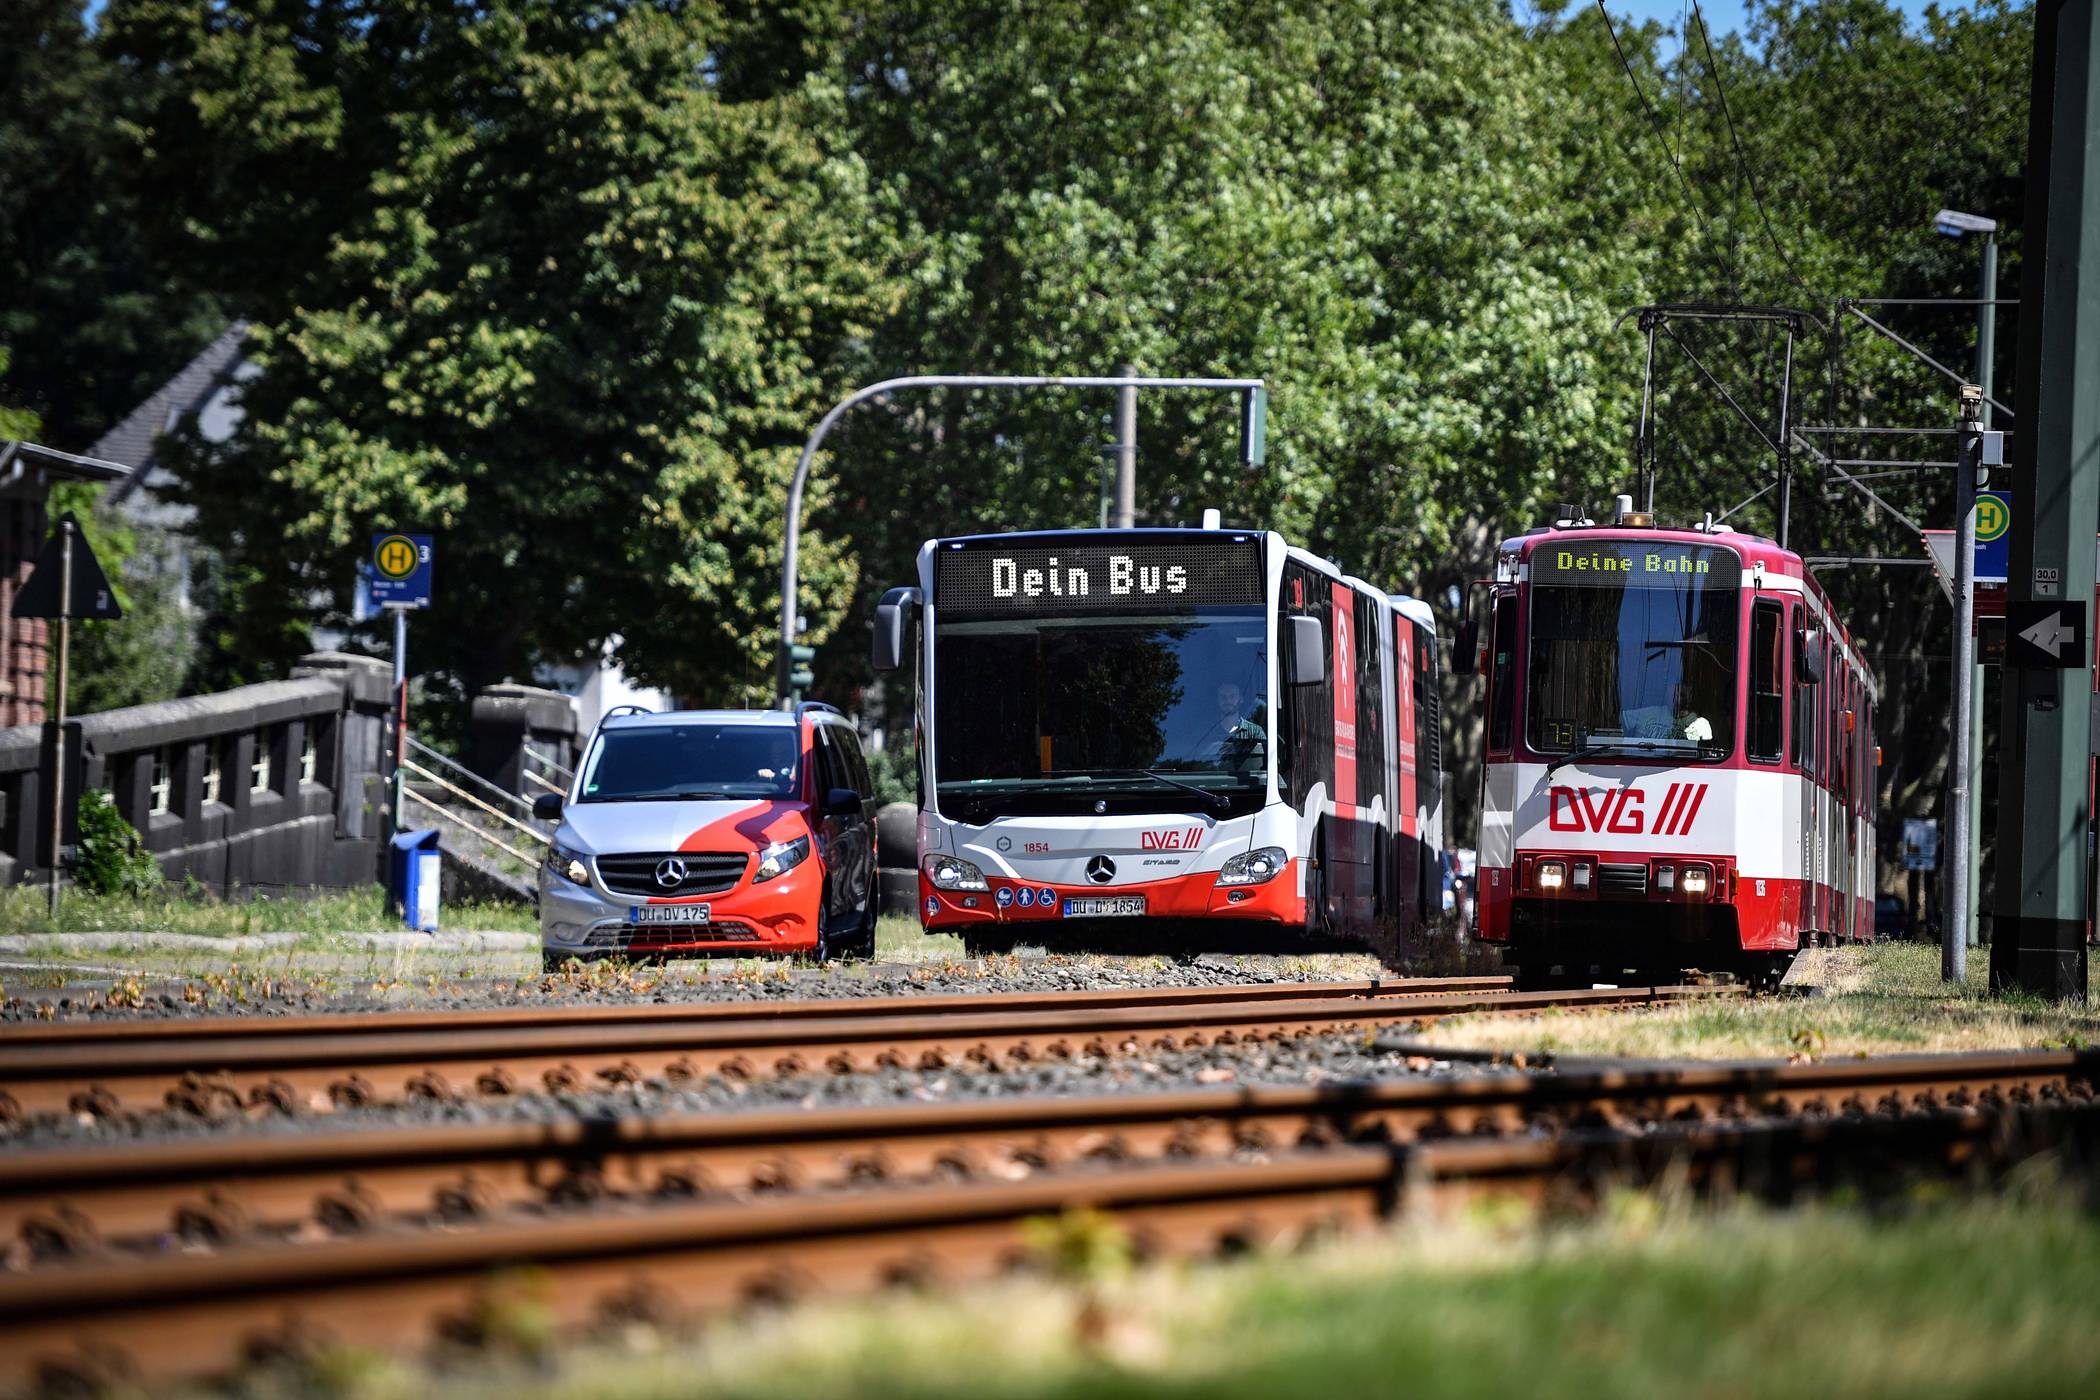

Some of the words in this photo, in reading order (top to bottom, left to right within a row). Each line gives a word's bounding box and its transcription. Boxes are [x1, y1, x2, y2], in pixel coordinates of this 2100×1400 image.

[1976, 507, 1996, 529] H
[388, 546, 406, 569] H
[419, 545, 431, 563] 3
[1557, 552, 1633, 571] Deine
[1645, 554, 1709, 573] Bahn
[993, 557, 1089, 597] Dein
[1109, 555, 1187, 595] Bus
[2042, 584, 2049, 593] 1
[1549, 786, 1645, 834] DVG
[1023, 842, 1049, 853] 1854
[1141, 831, 1179, 849] DVG
[640, 908, 656, 921] DU
[664, 908, 680, 920] DV
[683, 907, 708, 920] 175
[1072, 901, 1087, 914] DU
